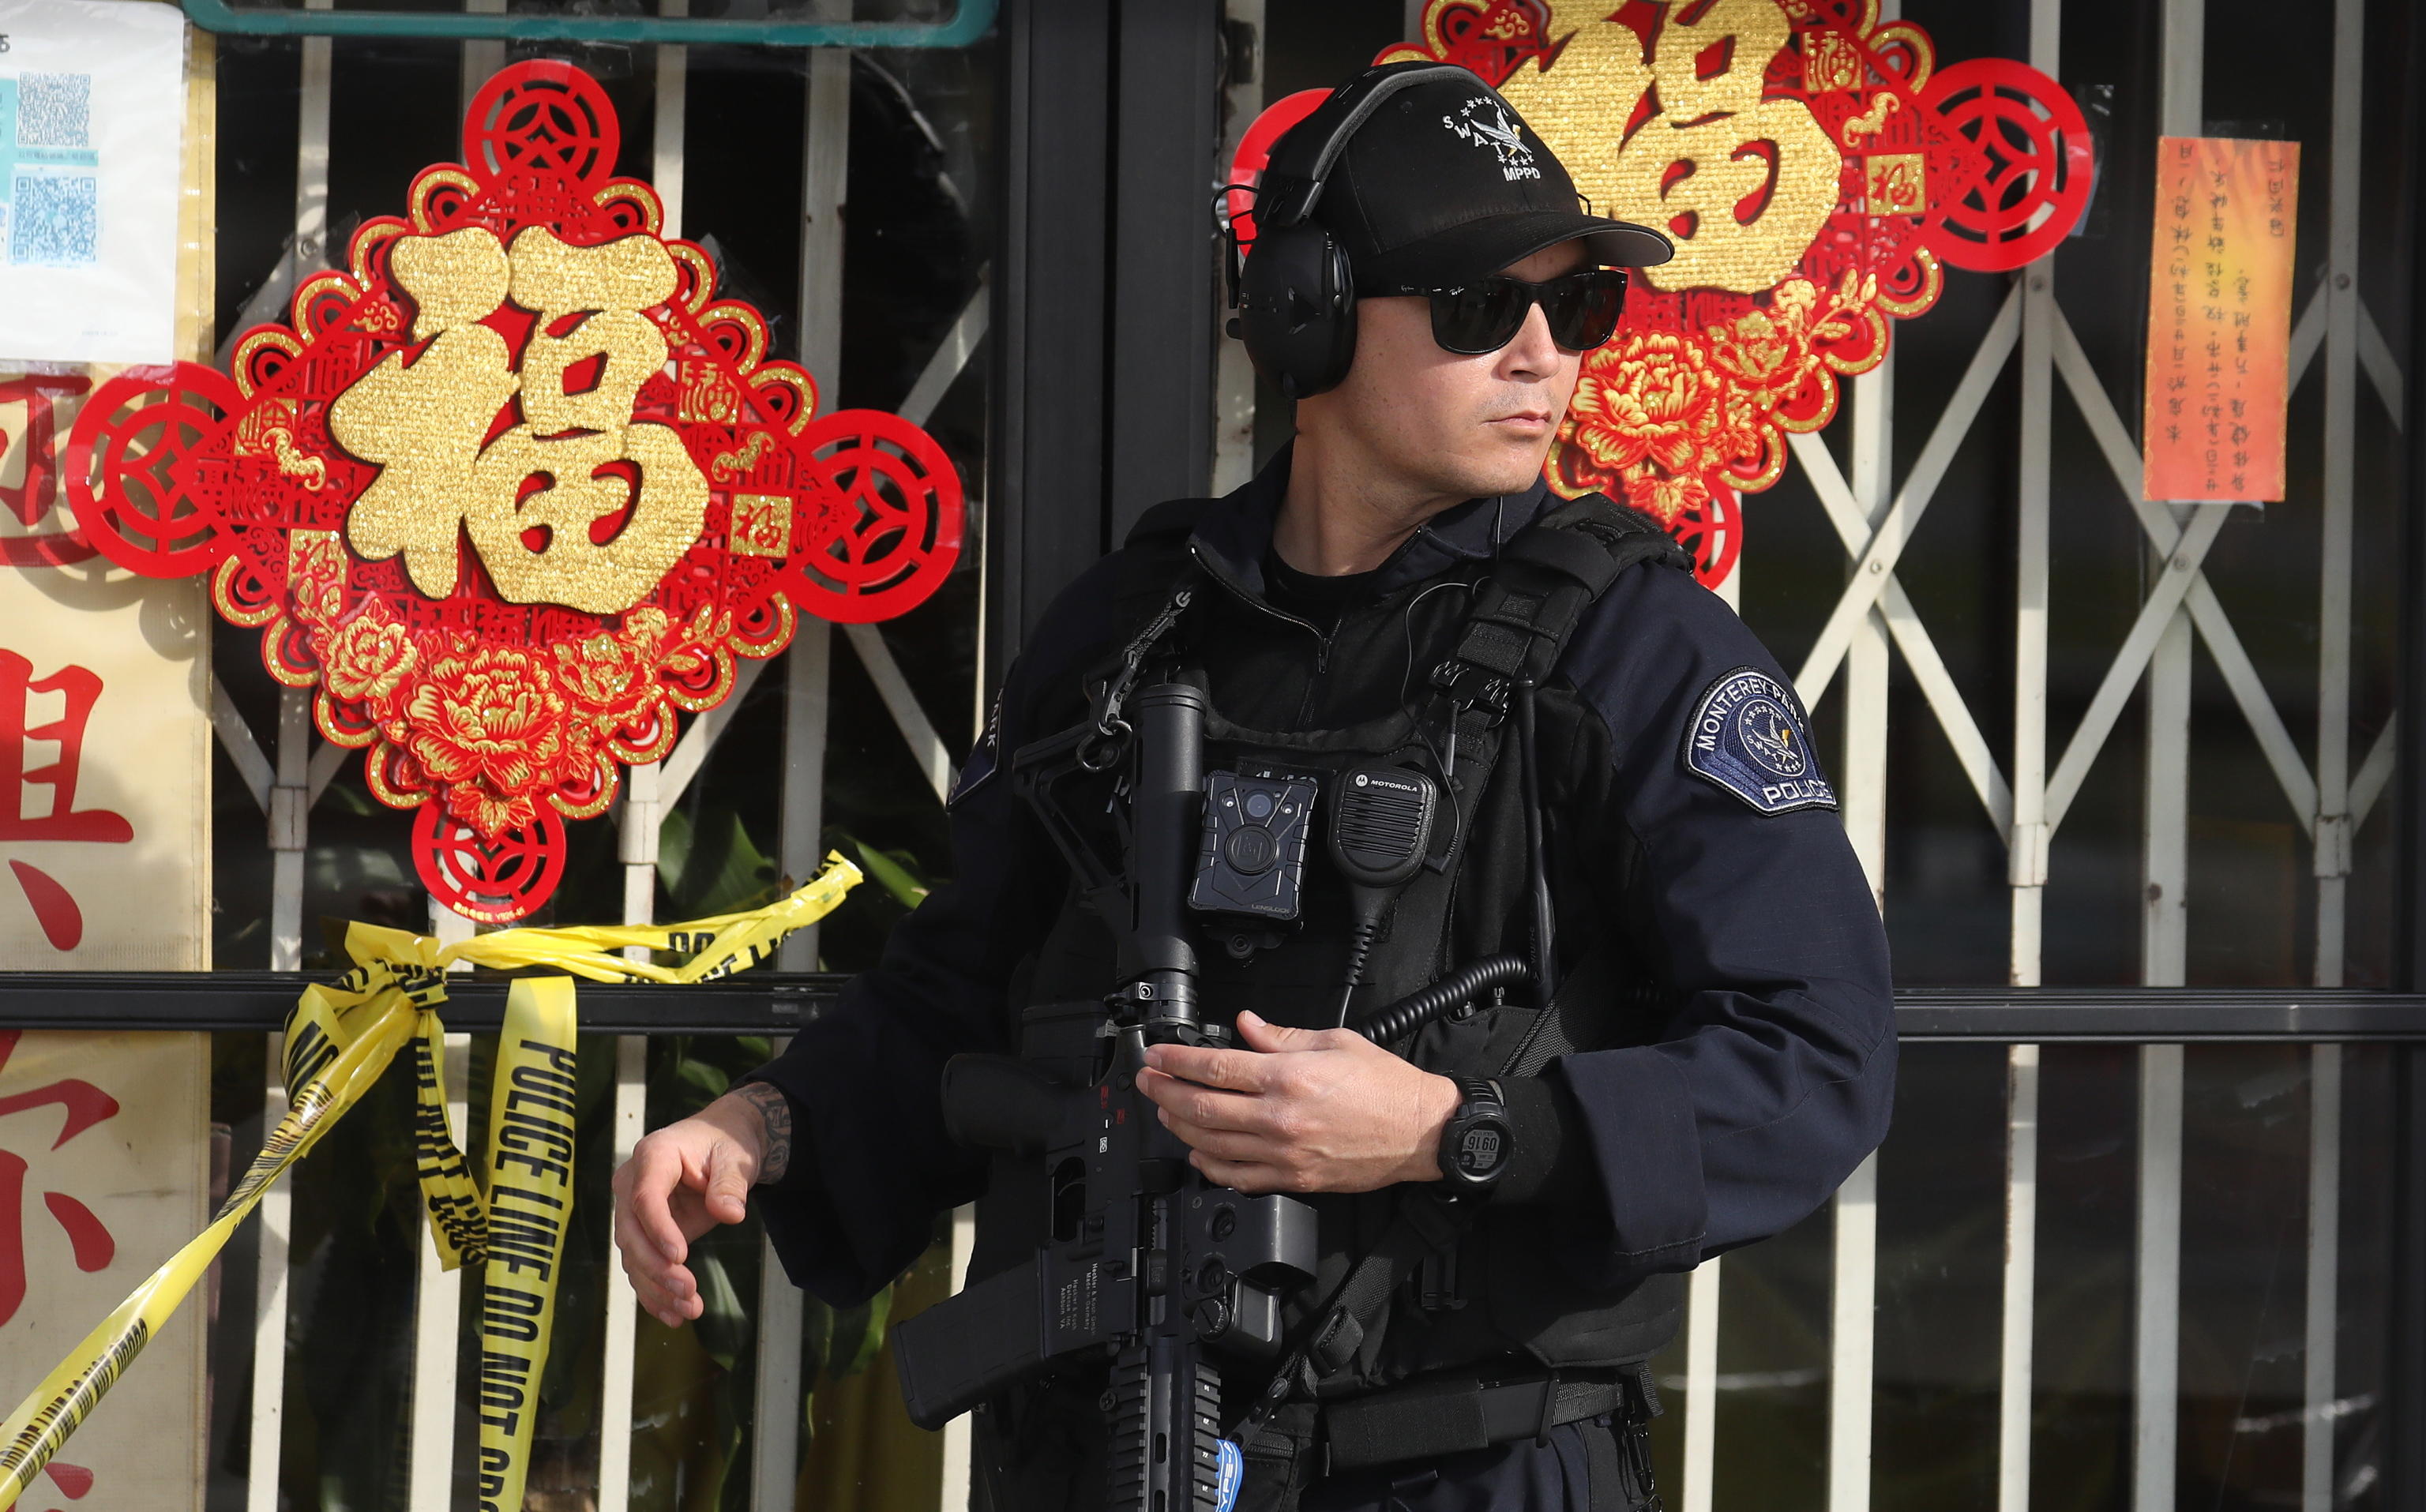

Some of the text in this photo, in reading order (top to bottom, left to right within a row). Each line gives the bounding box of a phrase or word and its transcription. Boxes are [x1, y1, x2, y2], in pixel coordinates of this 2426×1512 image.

[1442, 115, 1503, 156] SWAT
[1503, 166, 1541, 182] MPPD
[330, 224, 709, 614] 福
[1696, 677, 1805, 752] MONTEREY PARK
[1747, 734, 1778, 761] SWAT
[1370, 779, 1418, 793] MOTOROLA
[1762, 779, 1832, 805] POLICE
[495, 1037, 576, 1187] POLICE
[1467, 1135, 1497, 1151] 0916
[489, 1185, 563, 1283] LINE
[484, 1284, 545, 1343] DO
[480, 1351, 531, 1437] NOT
